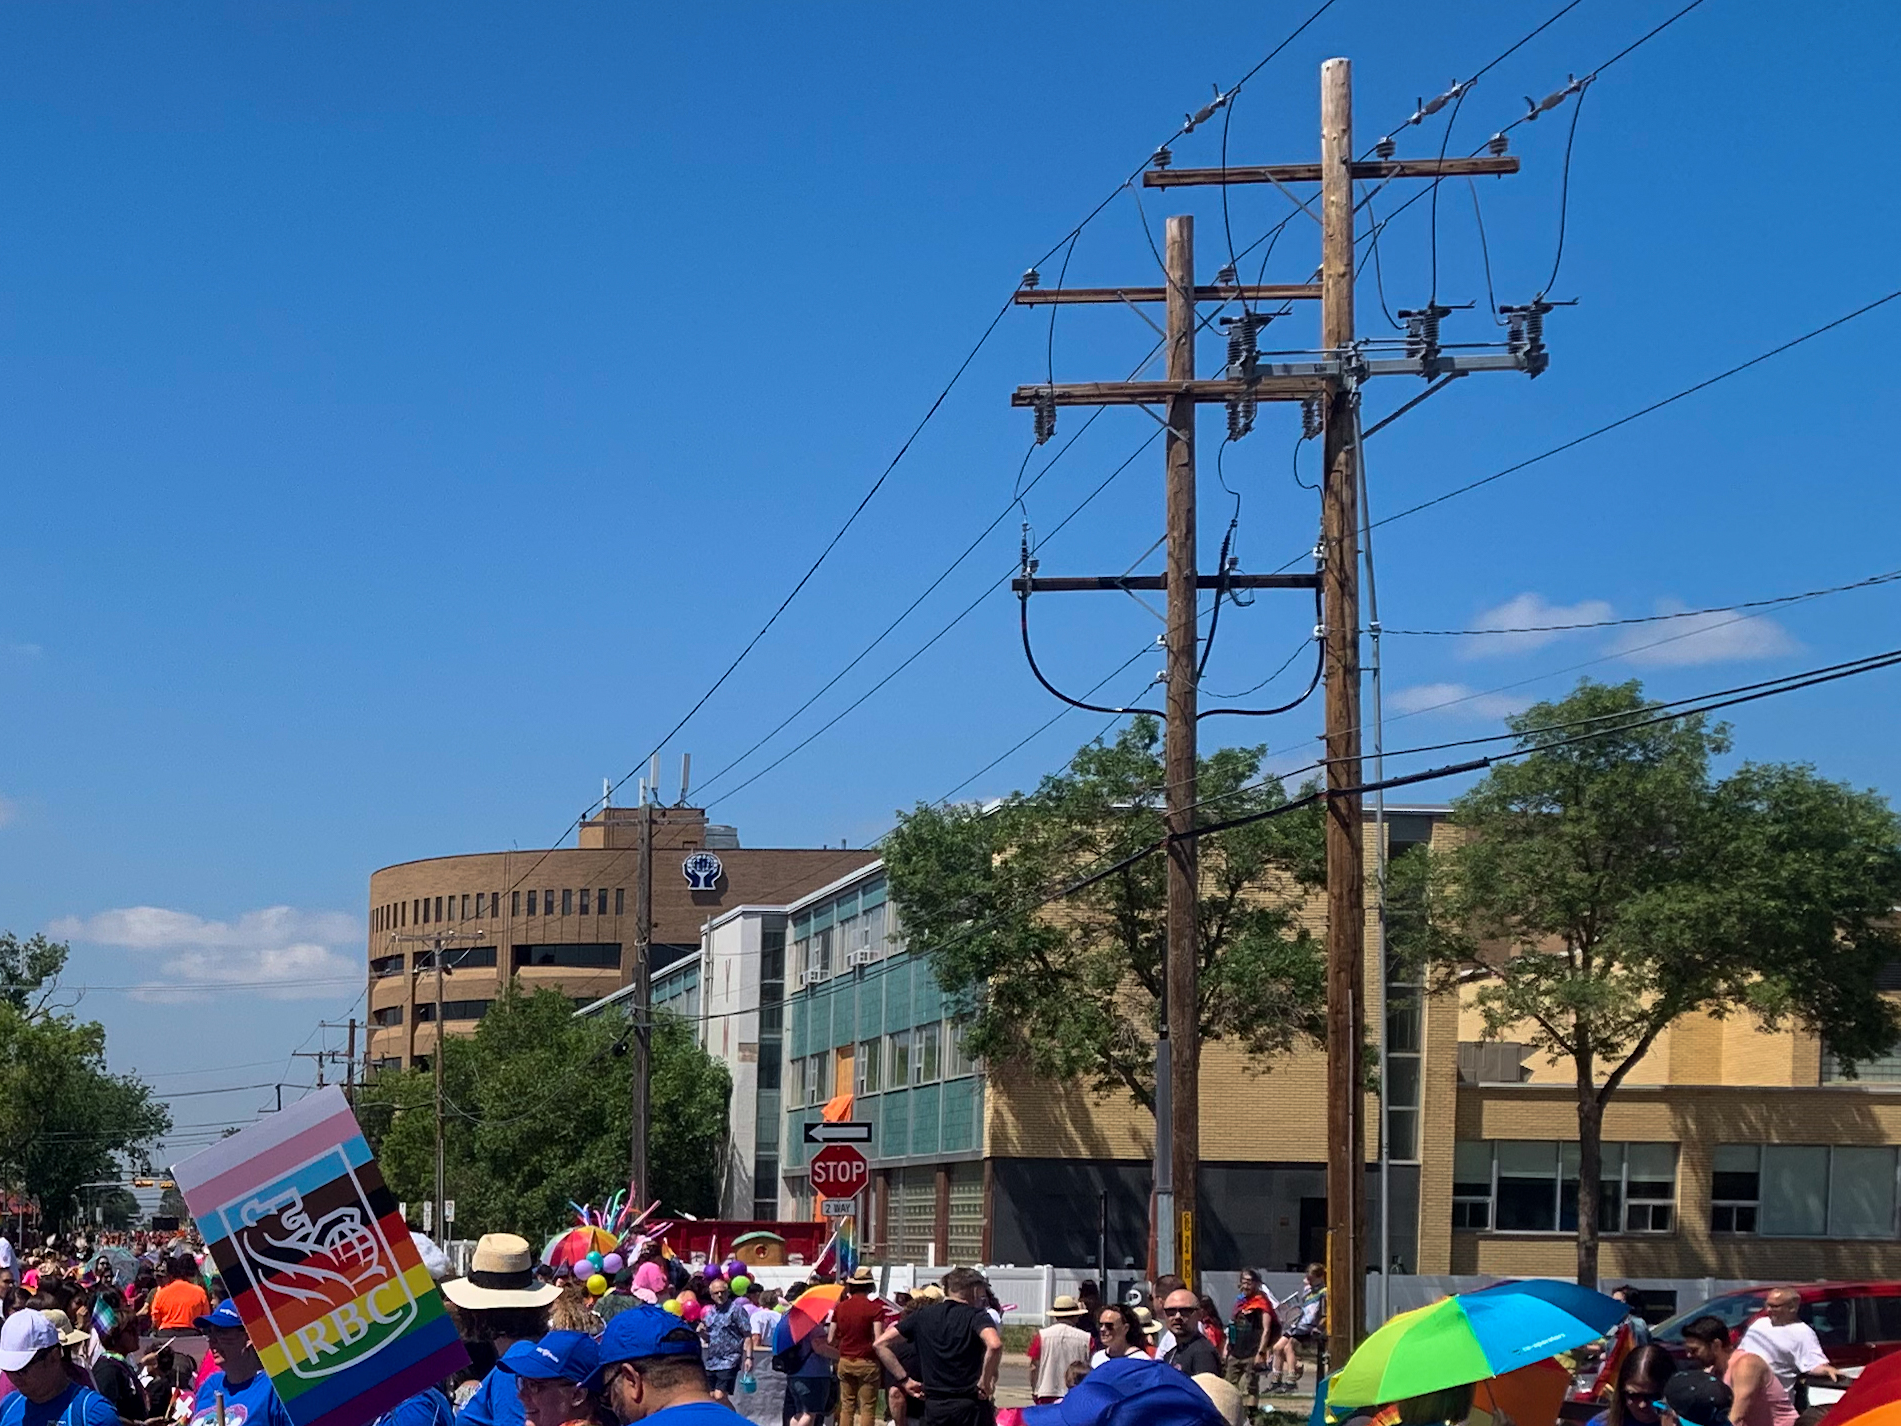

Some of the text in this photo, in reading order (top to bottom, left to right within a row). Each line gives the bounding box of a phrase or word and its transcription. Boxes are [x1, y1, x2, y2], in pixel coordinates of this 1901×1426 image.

[813, 1161, 865, 1183] STOP
[825, 1204, 851, 1213] 2 WAY
[295, 1283, 403, 1366] RBC
